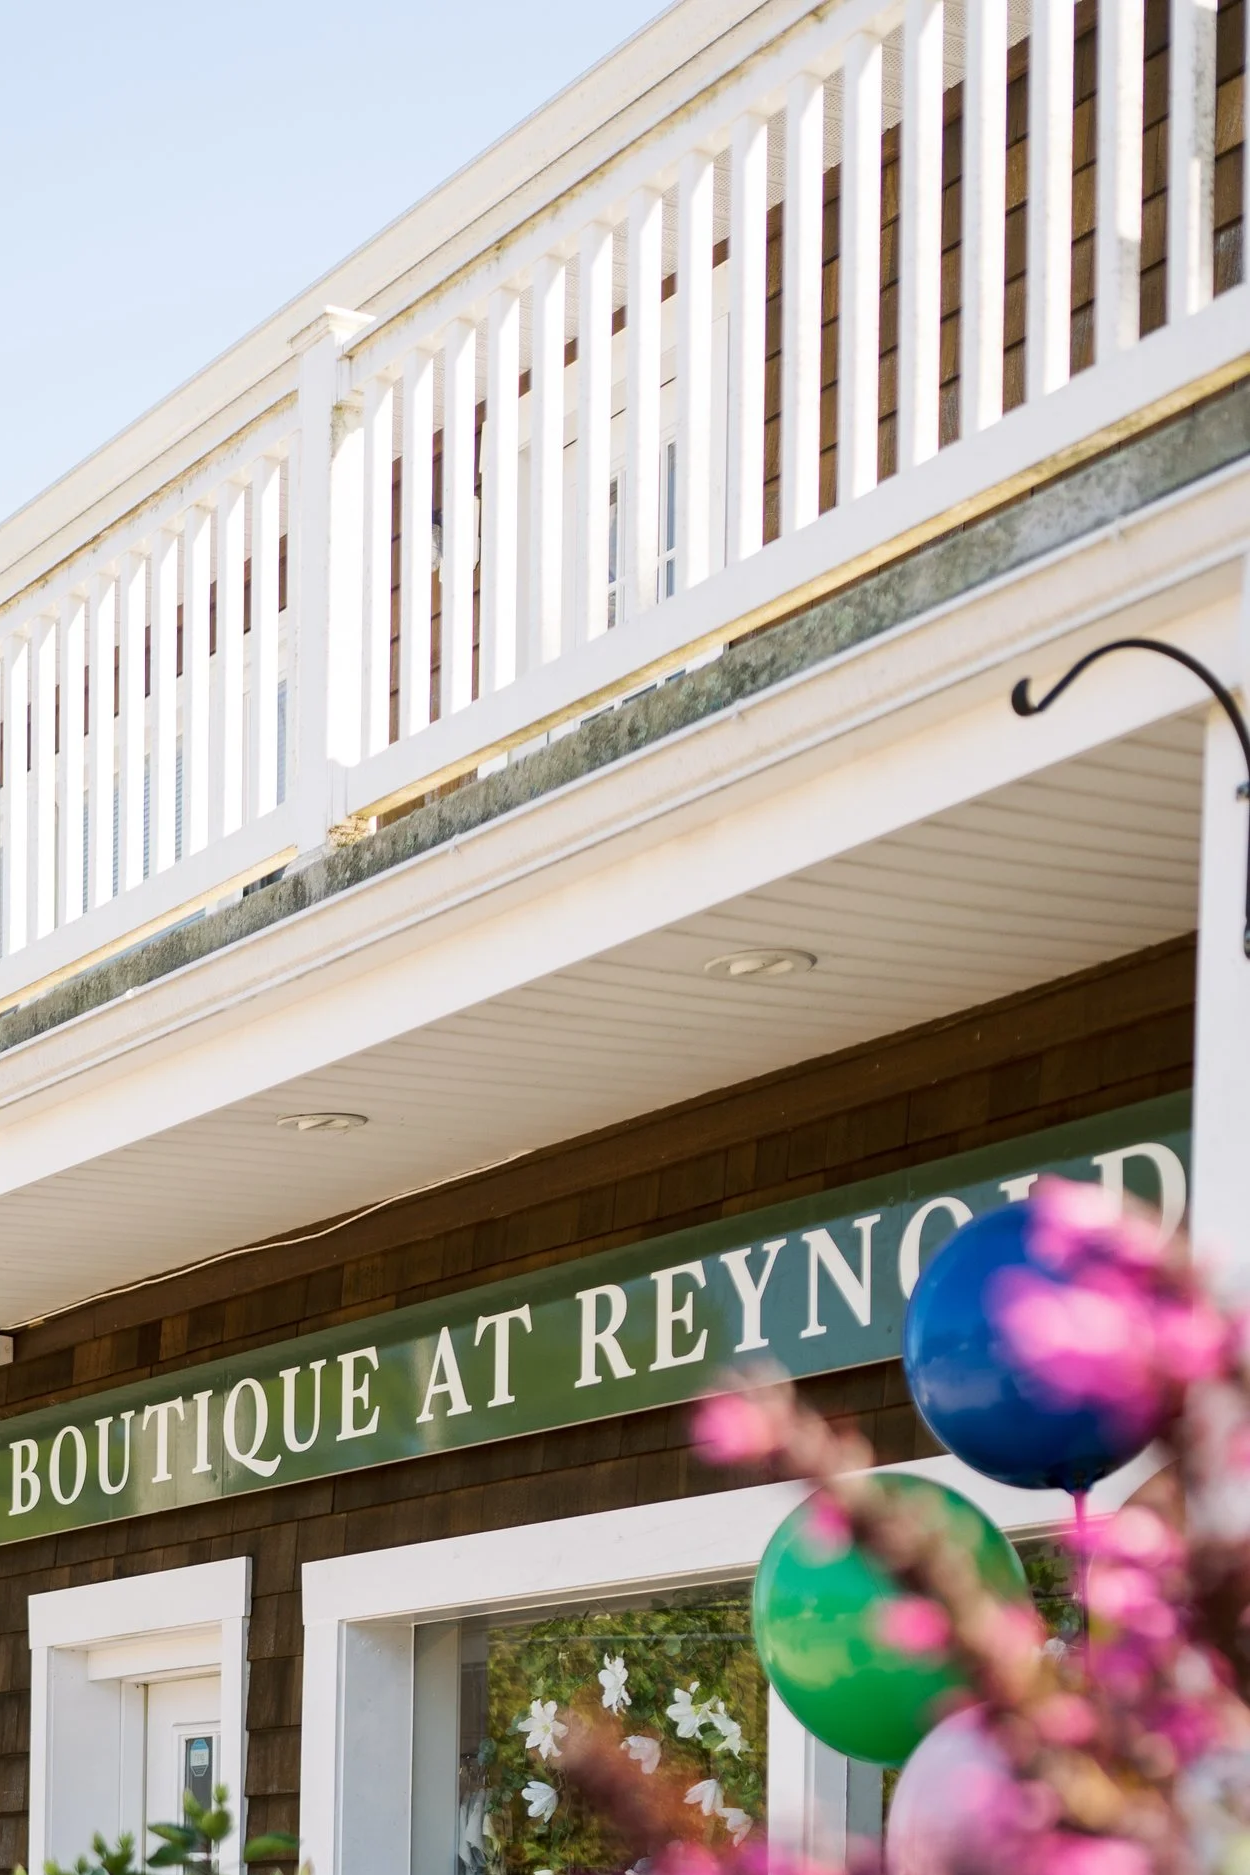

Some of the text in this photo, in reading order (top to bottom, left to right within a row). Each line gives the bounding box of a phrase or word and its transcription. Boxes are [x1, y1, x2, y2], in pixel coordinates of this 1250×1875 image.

[8, 1346, 381, 1516] BOUTIQUE
[416, 1303, 533, 1424] AT
[574, 1142, 1187, 1389] REYNOD
